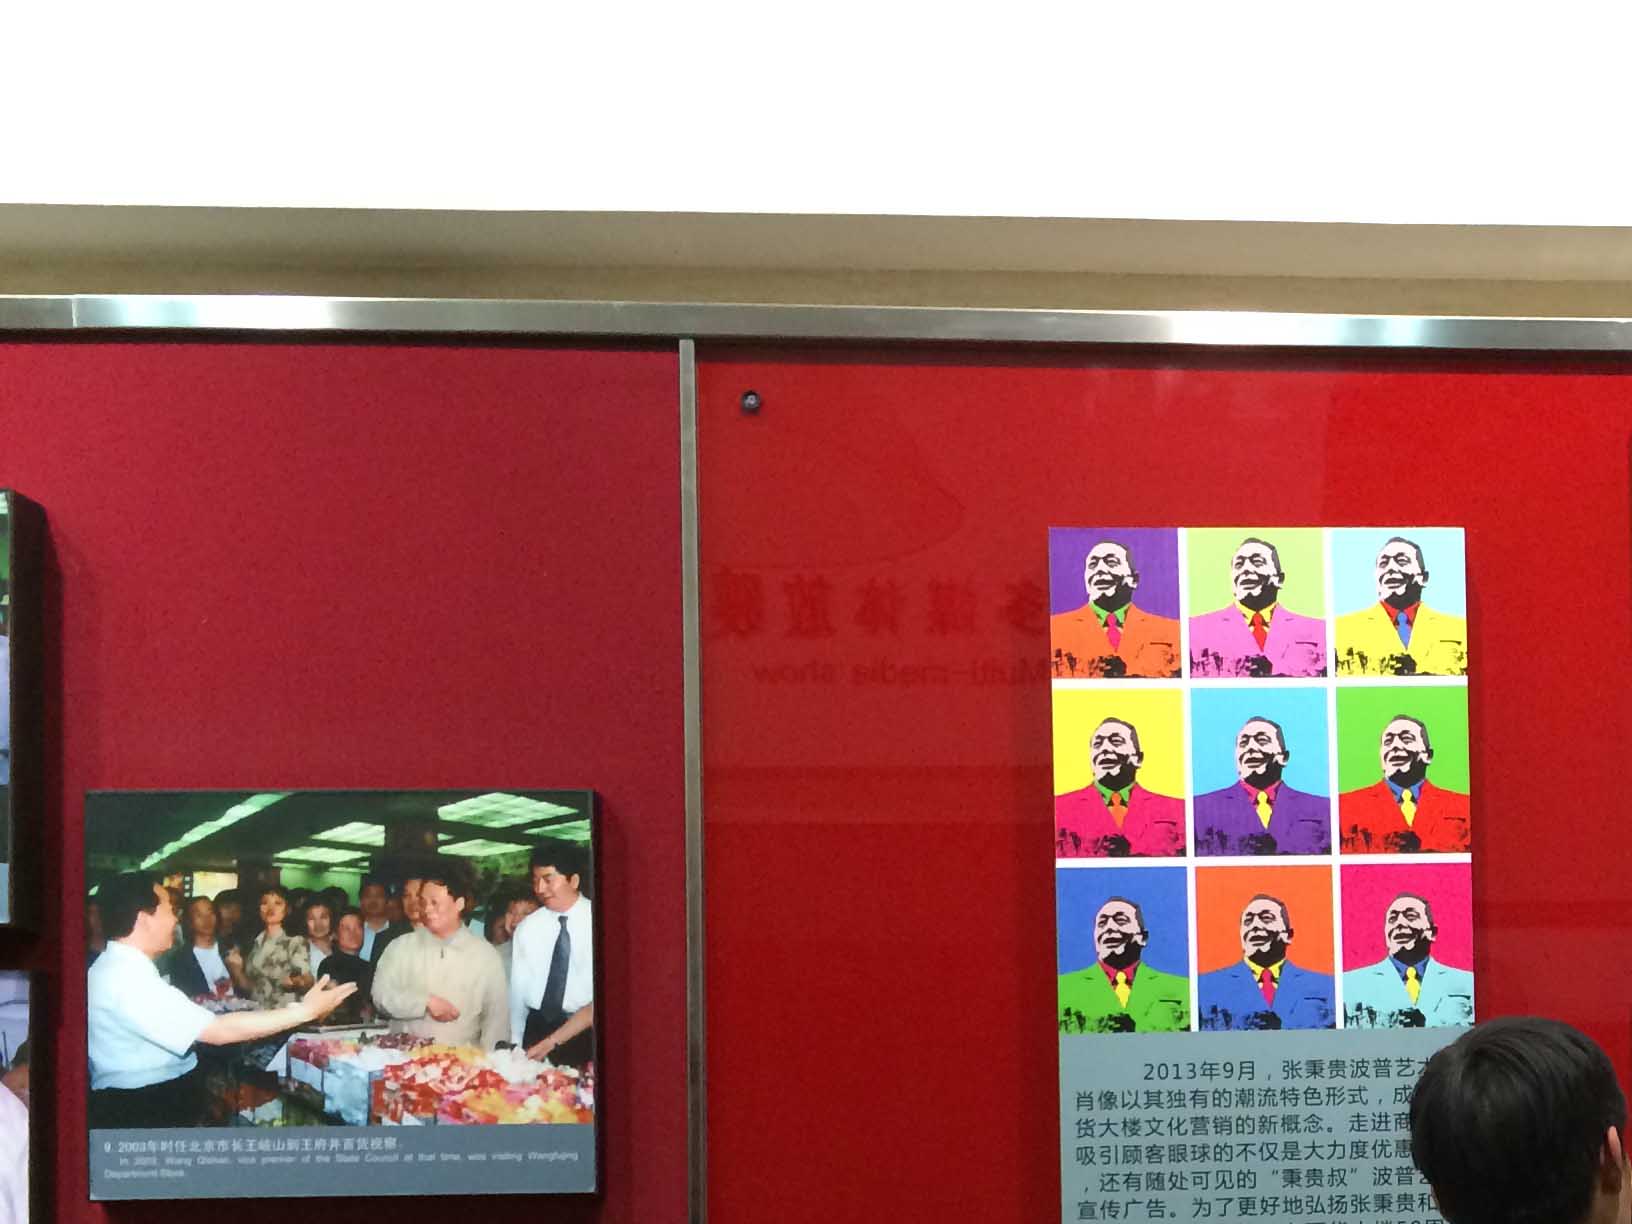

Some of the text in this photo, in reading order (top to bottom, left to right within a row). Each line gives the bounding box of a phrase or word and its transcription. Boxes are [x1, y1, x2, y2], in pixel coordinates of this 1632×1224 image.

[1076, 1085, 1413, 1111] 肖像以其独有的潮流特色形式，成
[1076, 1112, 1412, 1138] 货大楼文化营销的新概念。走进商
[1076, 1139, 1412, 1165] 吸引顾客眼球的不仅是大力度优惠
